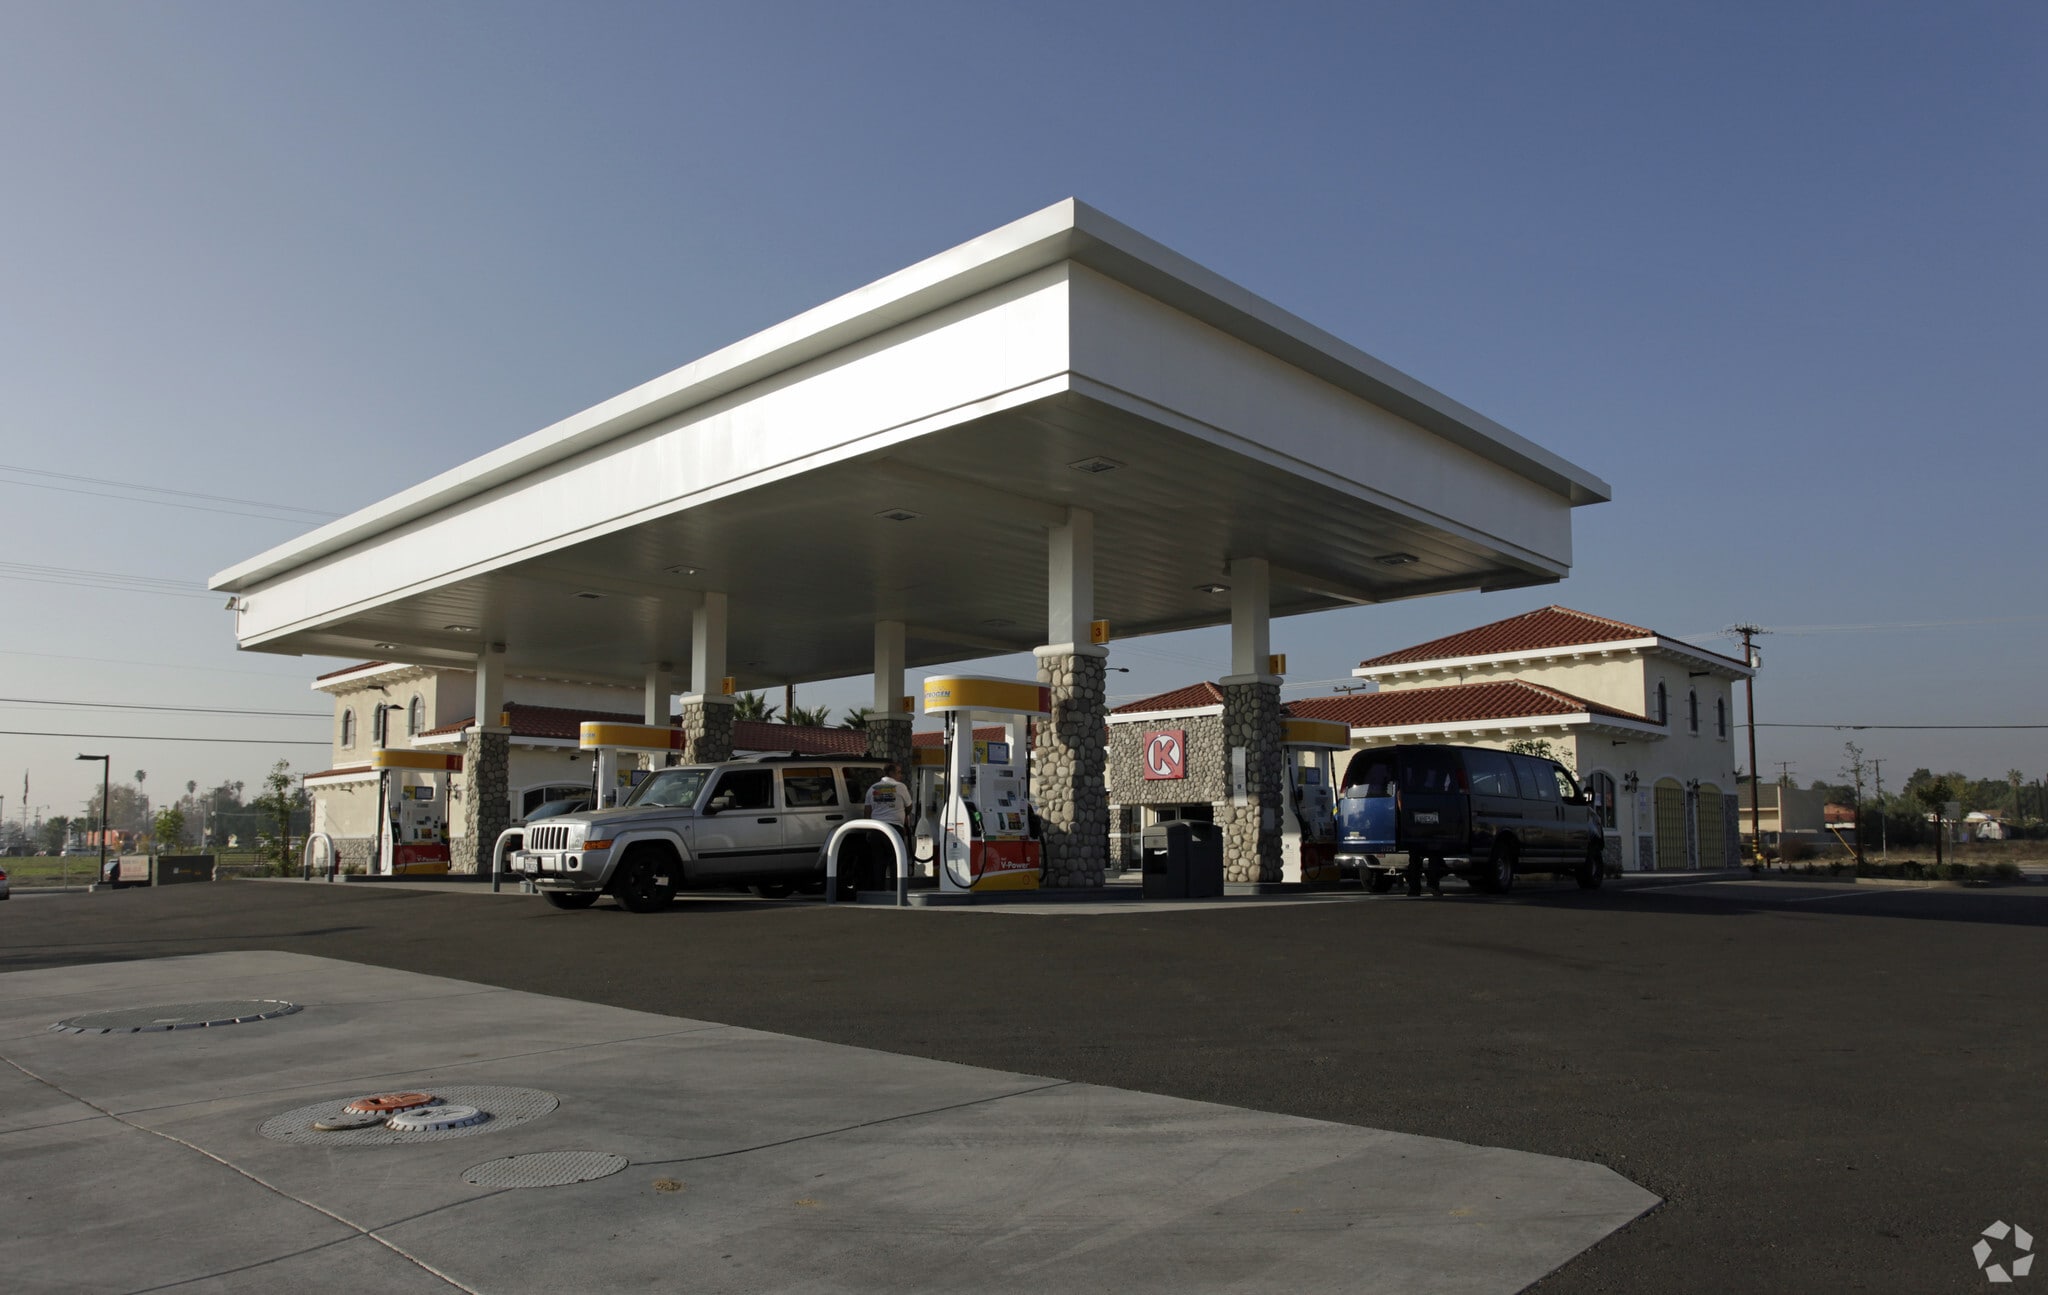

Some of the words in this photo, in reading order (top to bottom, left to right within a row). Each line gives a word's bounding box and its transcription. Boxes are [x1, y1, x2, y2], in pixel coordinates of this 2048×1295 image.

[1095, 627, 1102, 637] 3
[1153, 739, 1178, 774] K
[1001, 860, 1030, 869] V-Power
